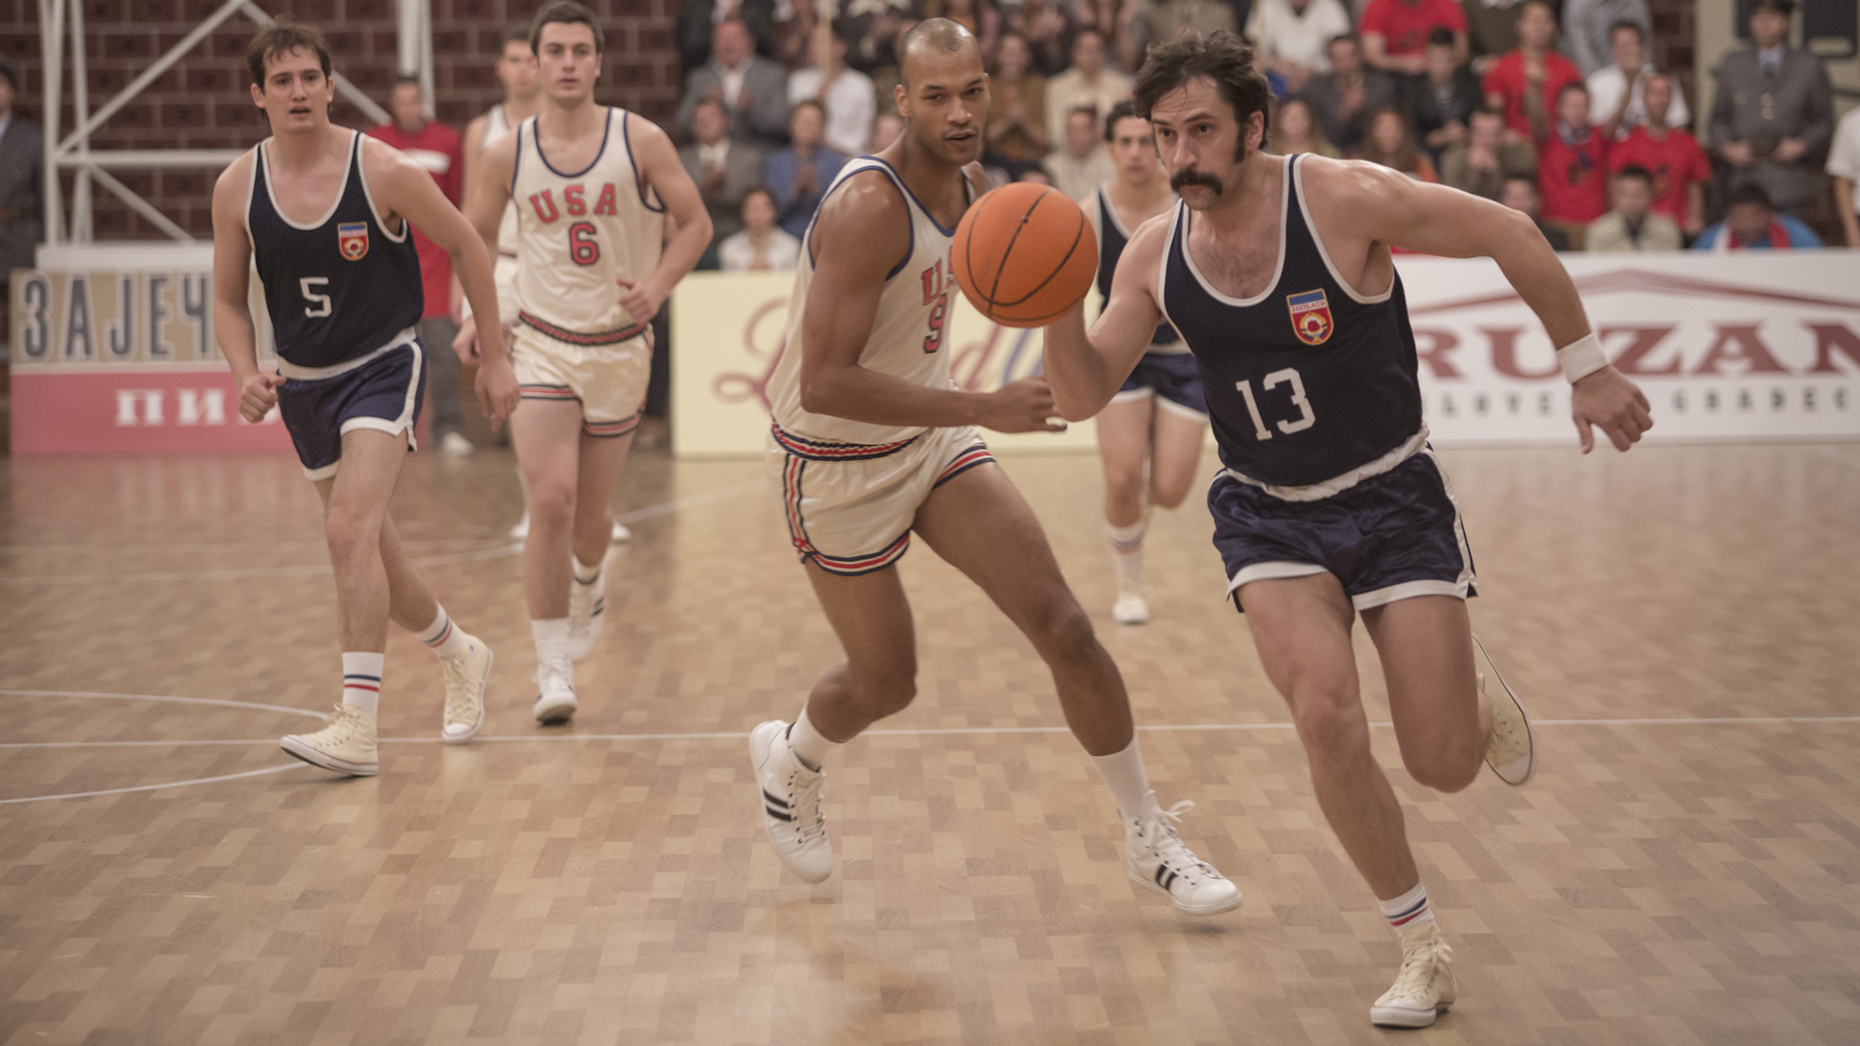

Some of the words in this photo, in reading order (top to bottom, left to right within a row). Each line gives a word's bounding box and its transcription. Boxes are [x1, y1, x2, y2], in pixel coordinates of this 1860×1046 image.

[529, 183, 617, 224] USA
[568, 221, 600, 266] 6
[23, 274, 278, 357] ЗАЈЕЧ
[299, 277, 332, 318] 5
[922, 292, 948, 354] 9
[1236, 367, 1316, 441] 13
